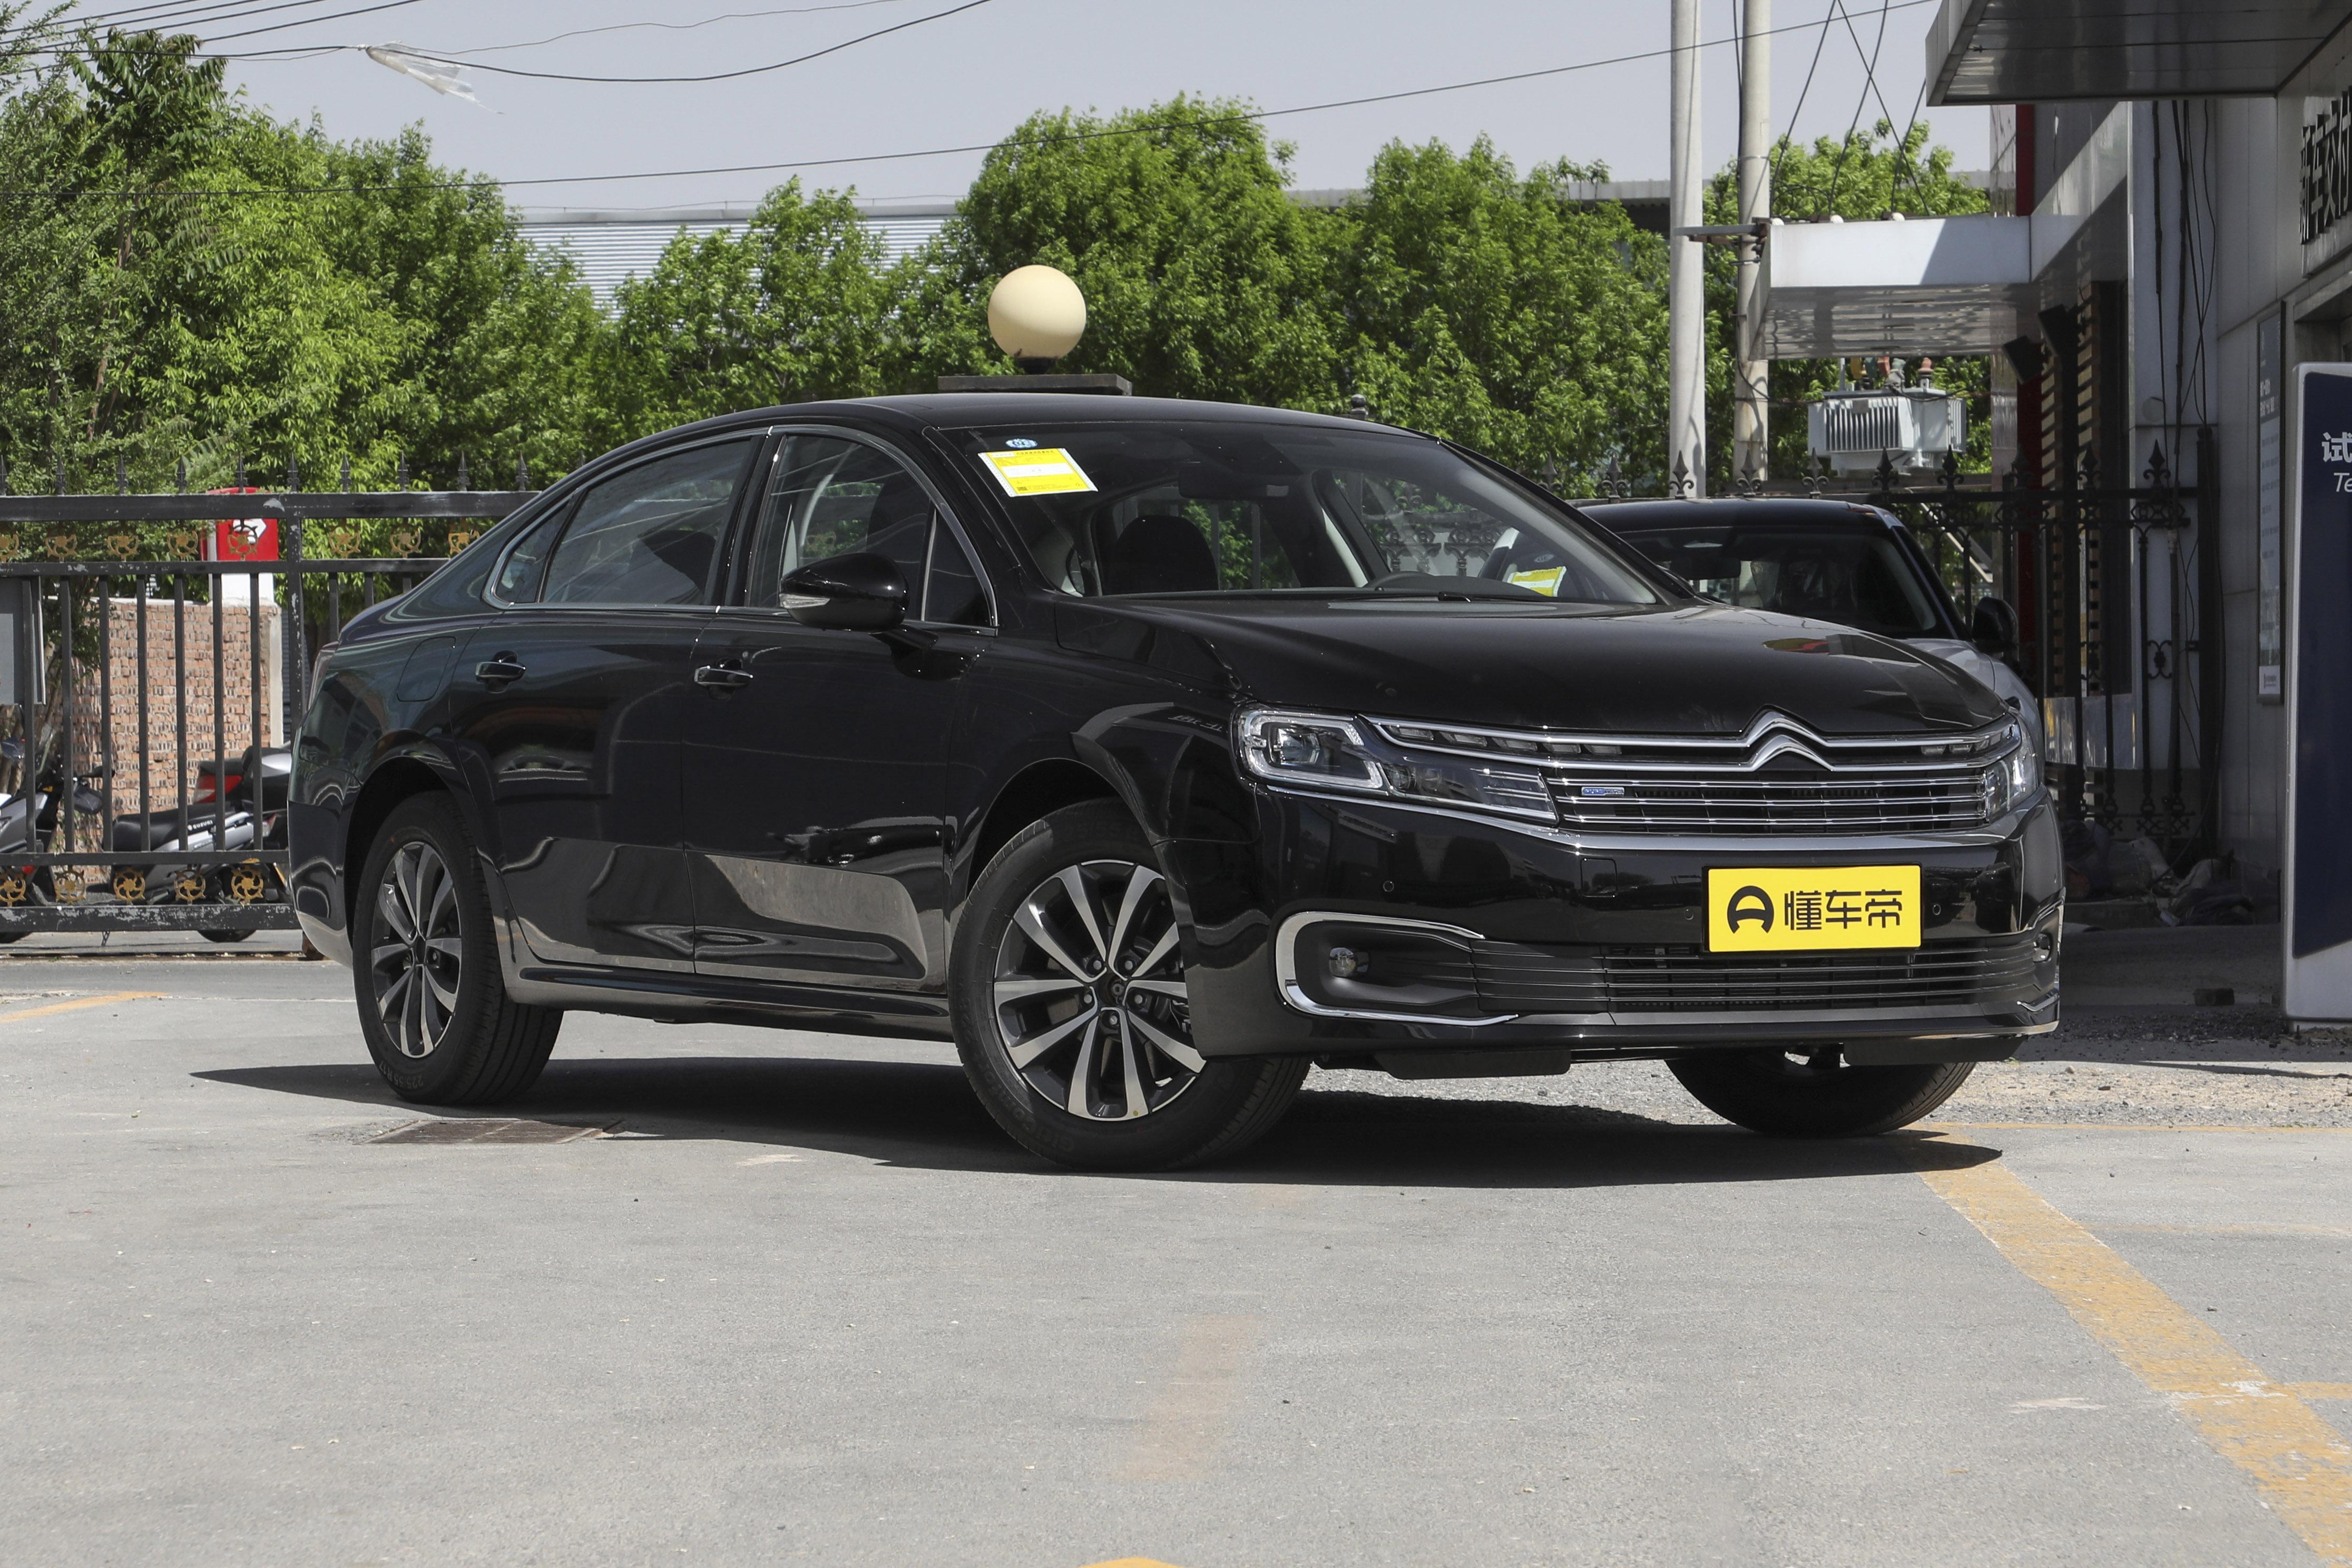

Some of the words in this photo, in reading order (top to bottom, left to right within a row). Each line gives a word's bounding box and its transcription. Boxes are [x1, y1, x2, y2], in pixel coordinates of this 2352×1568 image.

[2299, 94, 2351, 243] 新车交付
[1784, 888, 1903, 931] 懂车帝
